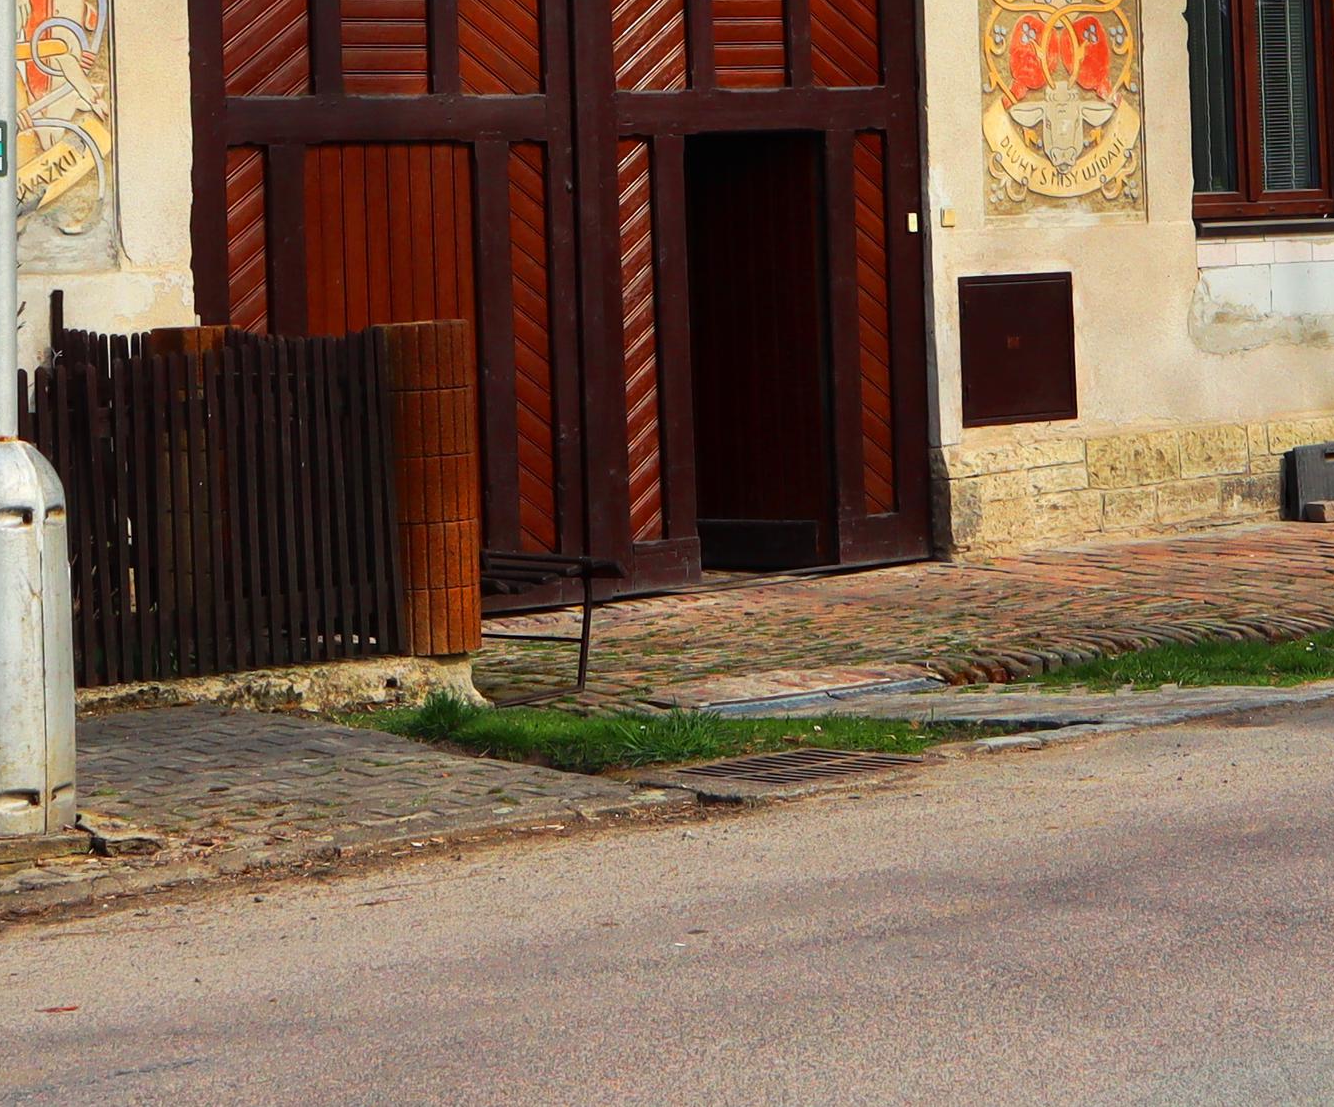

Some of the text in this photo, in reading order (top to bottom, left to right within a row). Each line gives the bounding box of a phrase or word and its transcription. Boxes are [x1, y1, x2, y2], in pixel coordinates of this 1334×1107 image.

[1000, 136, 1037, 178] DLUHY
[1040, 167, 1047, 186] S
[1082, 133, 1125, 181] UJÍDAJÍ
